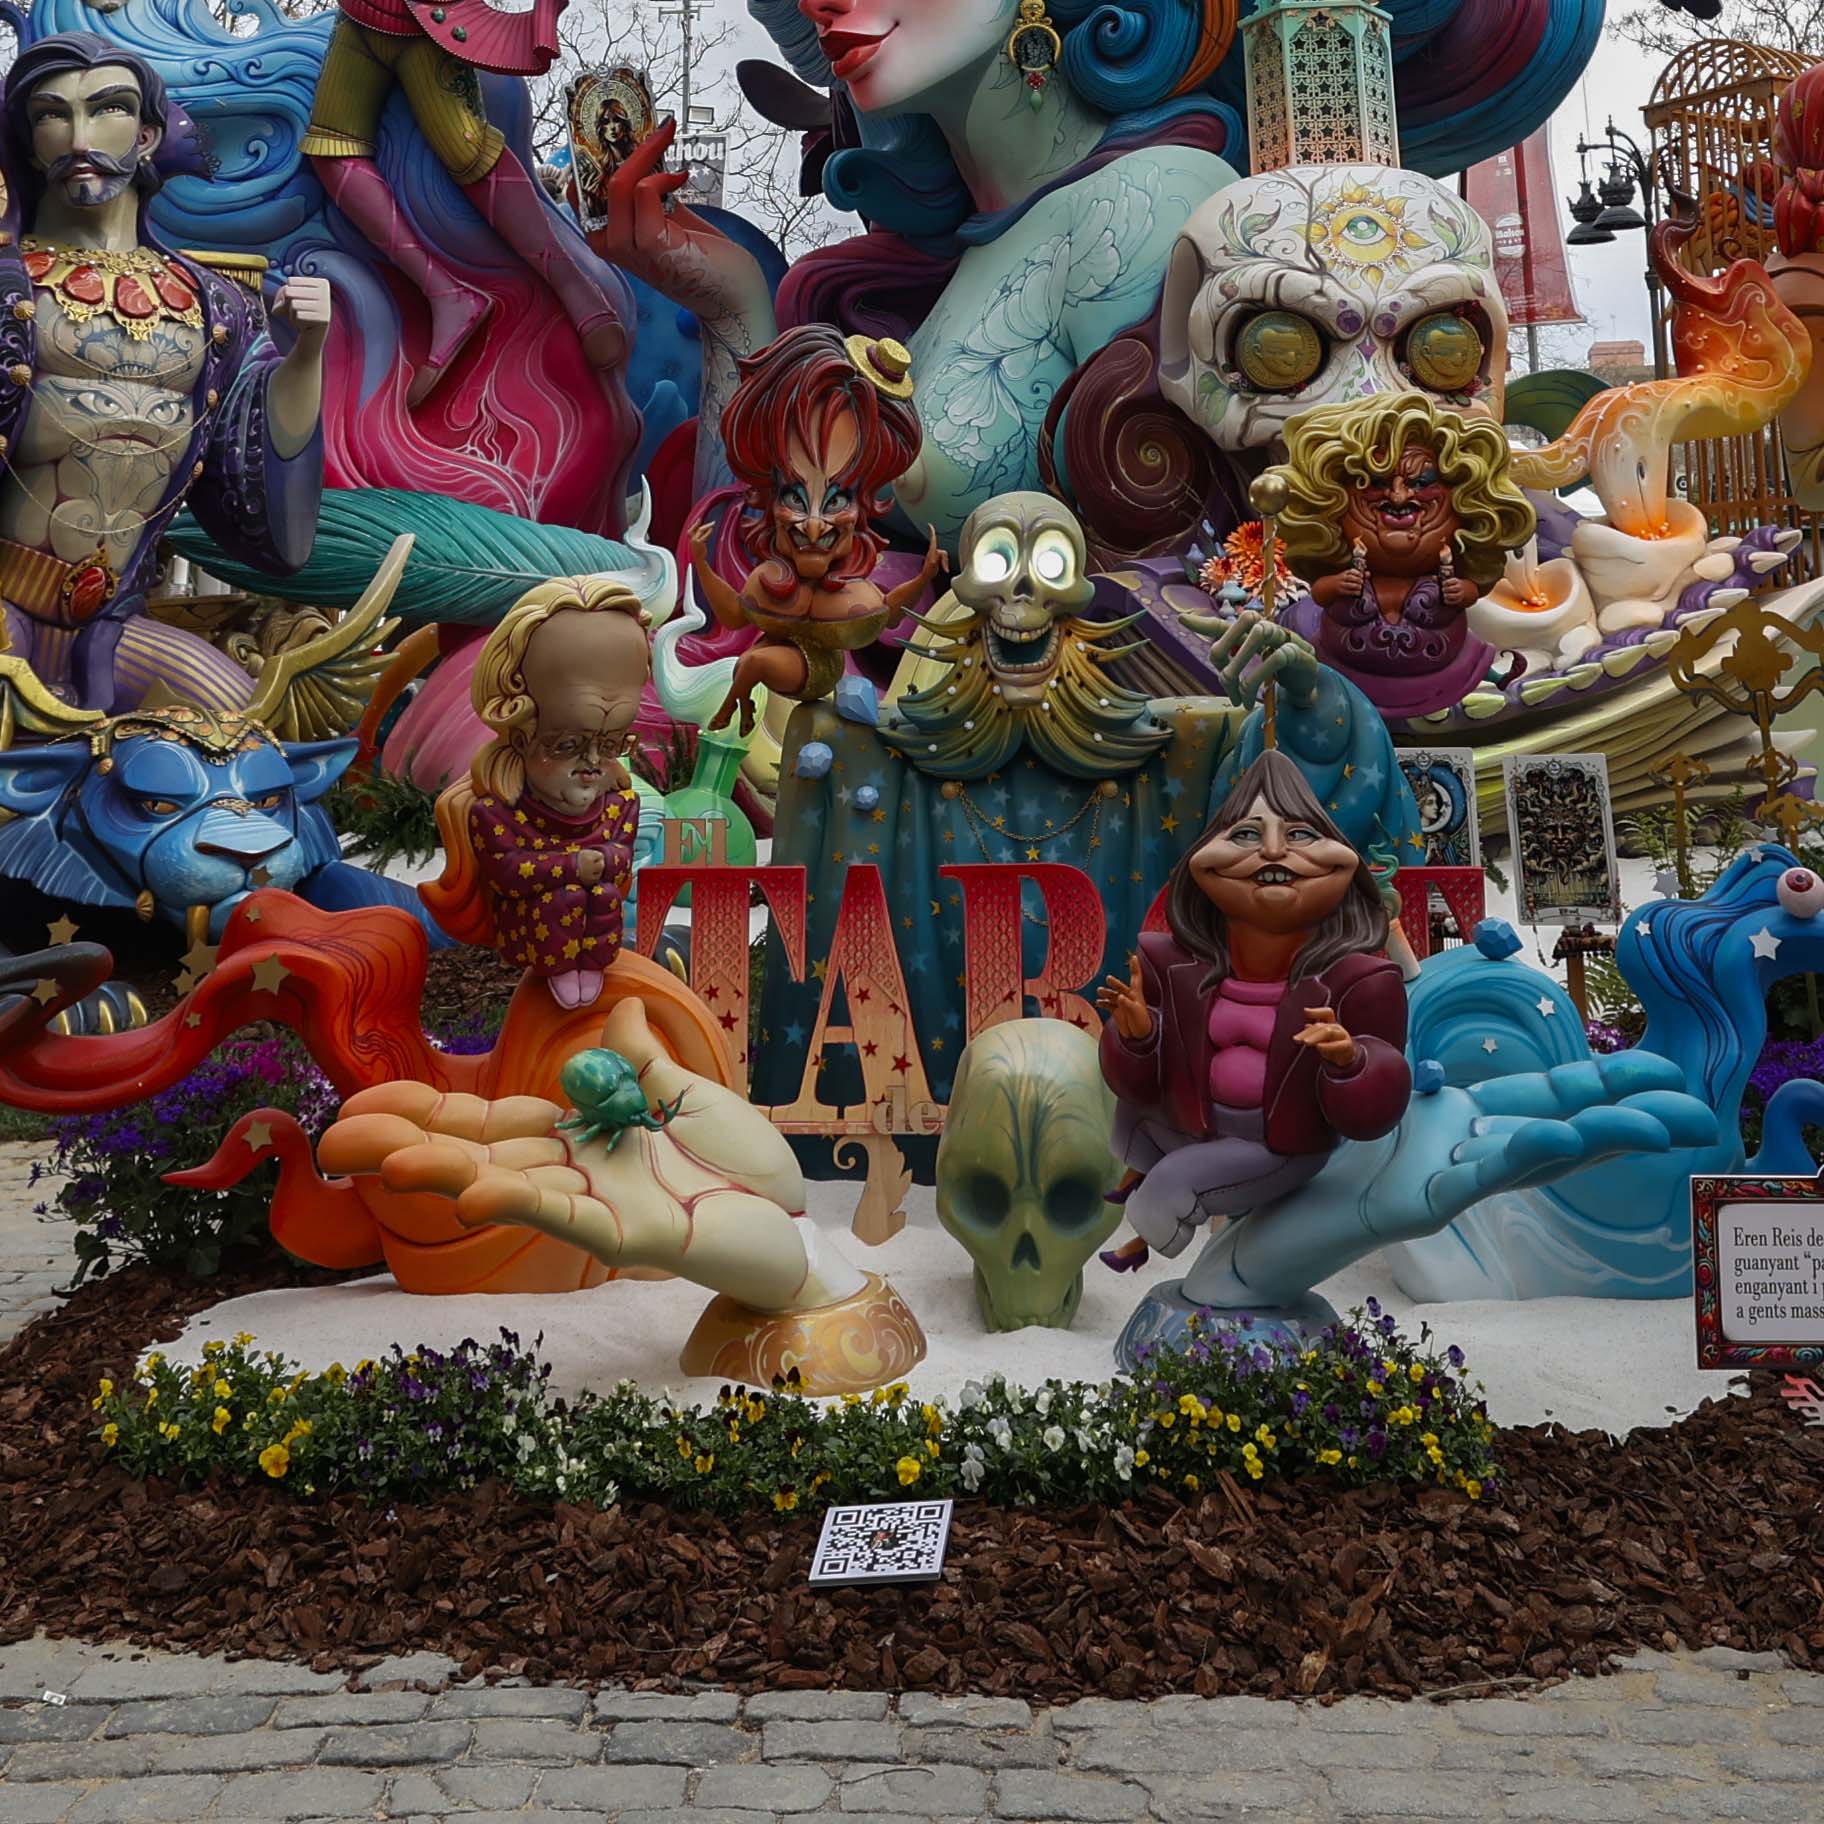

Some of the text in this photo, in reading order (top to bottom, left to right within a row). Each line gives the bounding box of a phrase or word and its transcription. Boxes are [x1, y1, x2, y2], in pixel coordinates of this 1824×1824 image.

[662, 817, 728, 866] El
[636, 862, 1486, 1123] TART
[871, 1084, 944, 1137] de
[1734, 1227, 1768, 1246] Eren
[1772, 1227, 1803, 1247] Reis
[1807, 1227, 1824, 1247] de
[1734, 1256, 1799, 1276] guanyant
[1735, 1280, 1808, 1300] enganyant
[1813, 1280, 1817, 1294] i
[1736, 1306, 1744, 1318] a
[1749, 1304, 1787, 1324] gents
